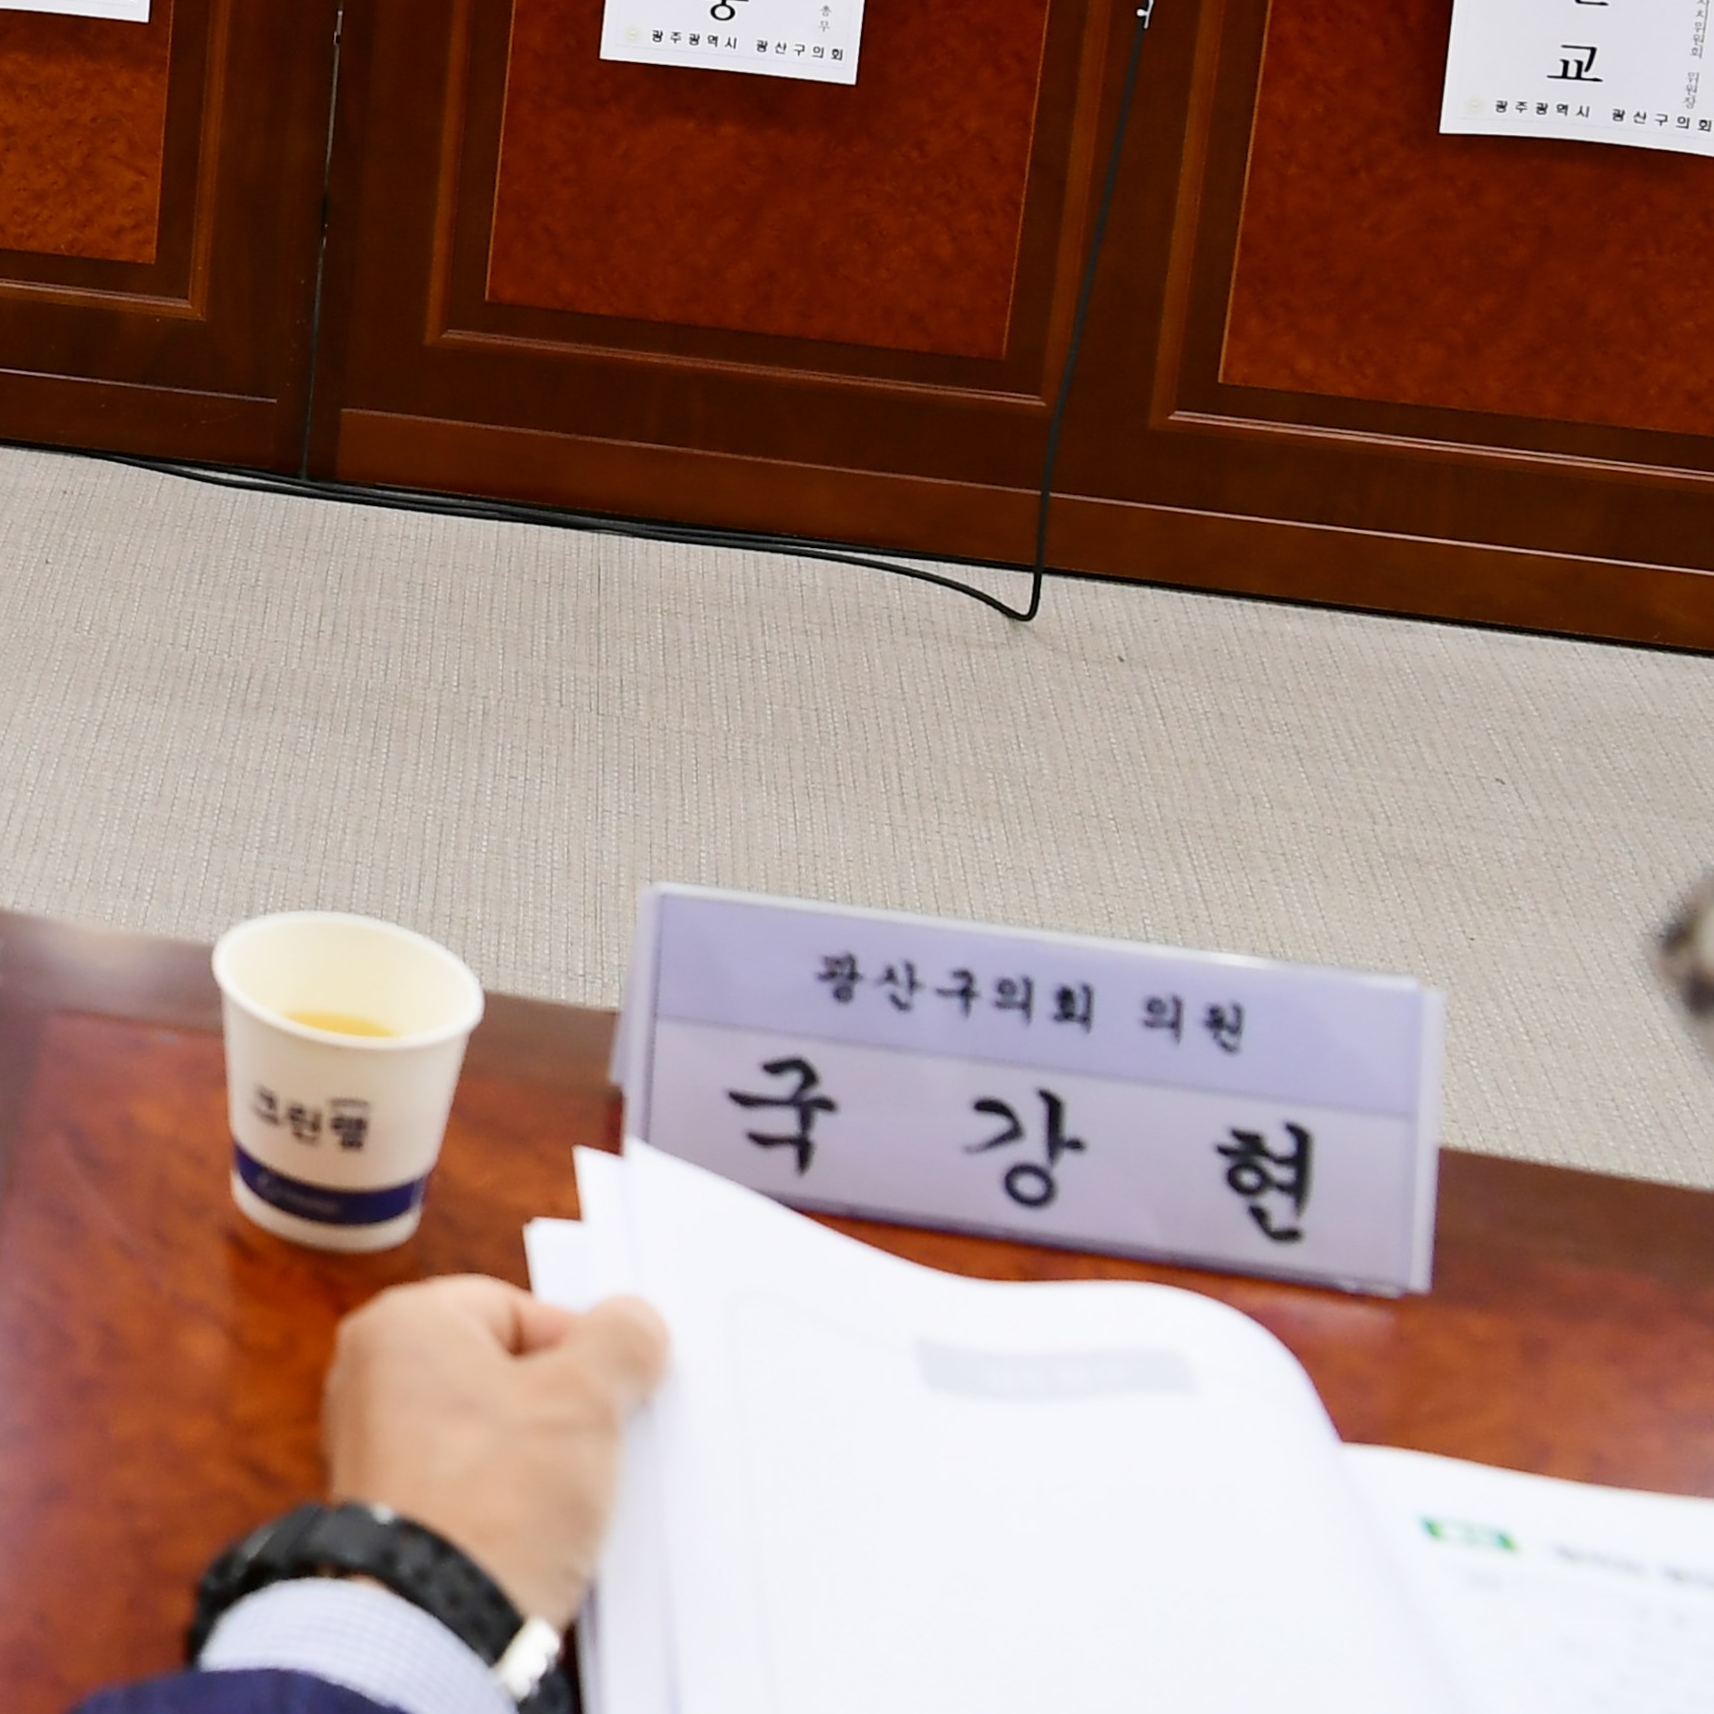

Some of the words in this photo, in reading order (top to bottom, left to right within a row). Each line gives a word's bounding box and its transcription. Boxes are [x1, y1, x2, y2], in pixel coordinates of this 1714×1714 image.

[651, 29, 738, 49] 광주광역시
[756, 40, 844, 61] 광산구의회
[1495, 99, 1591, 119] 광주광역시
[1611, 108, 1713, 133] 광산구의회
[817, 952, 1095, 1033] 광산구의회
[1140, 993, 1247, 1055] 의원
[727, 1055, 1314, 1243] 국강현
